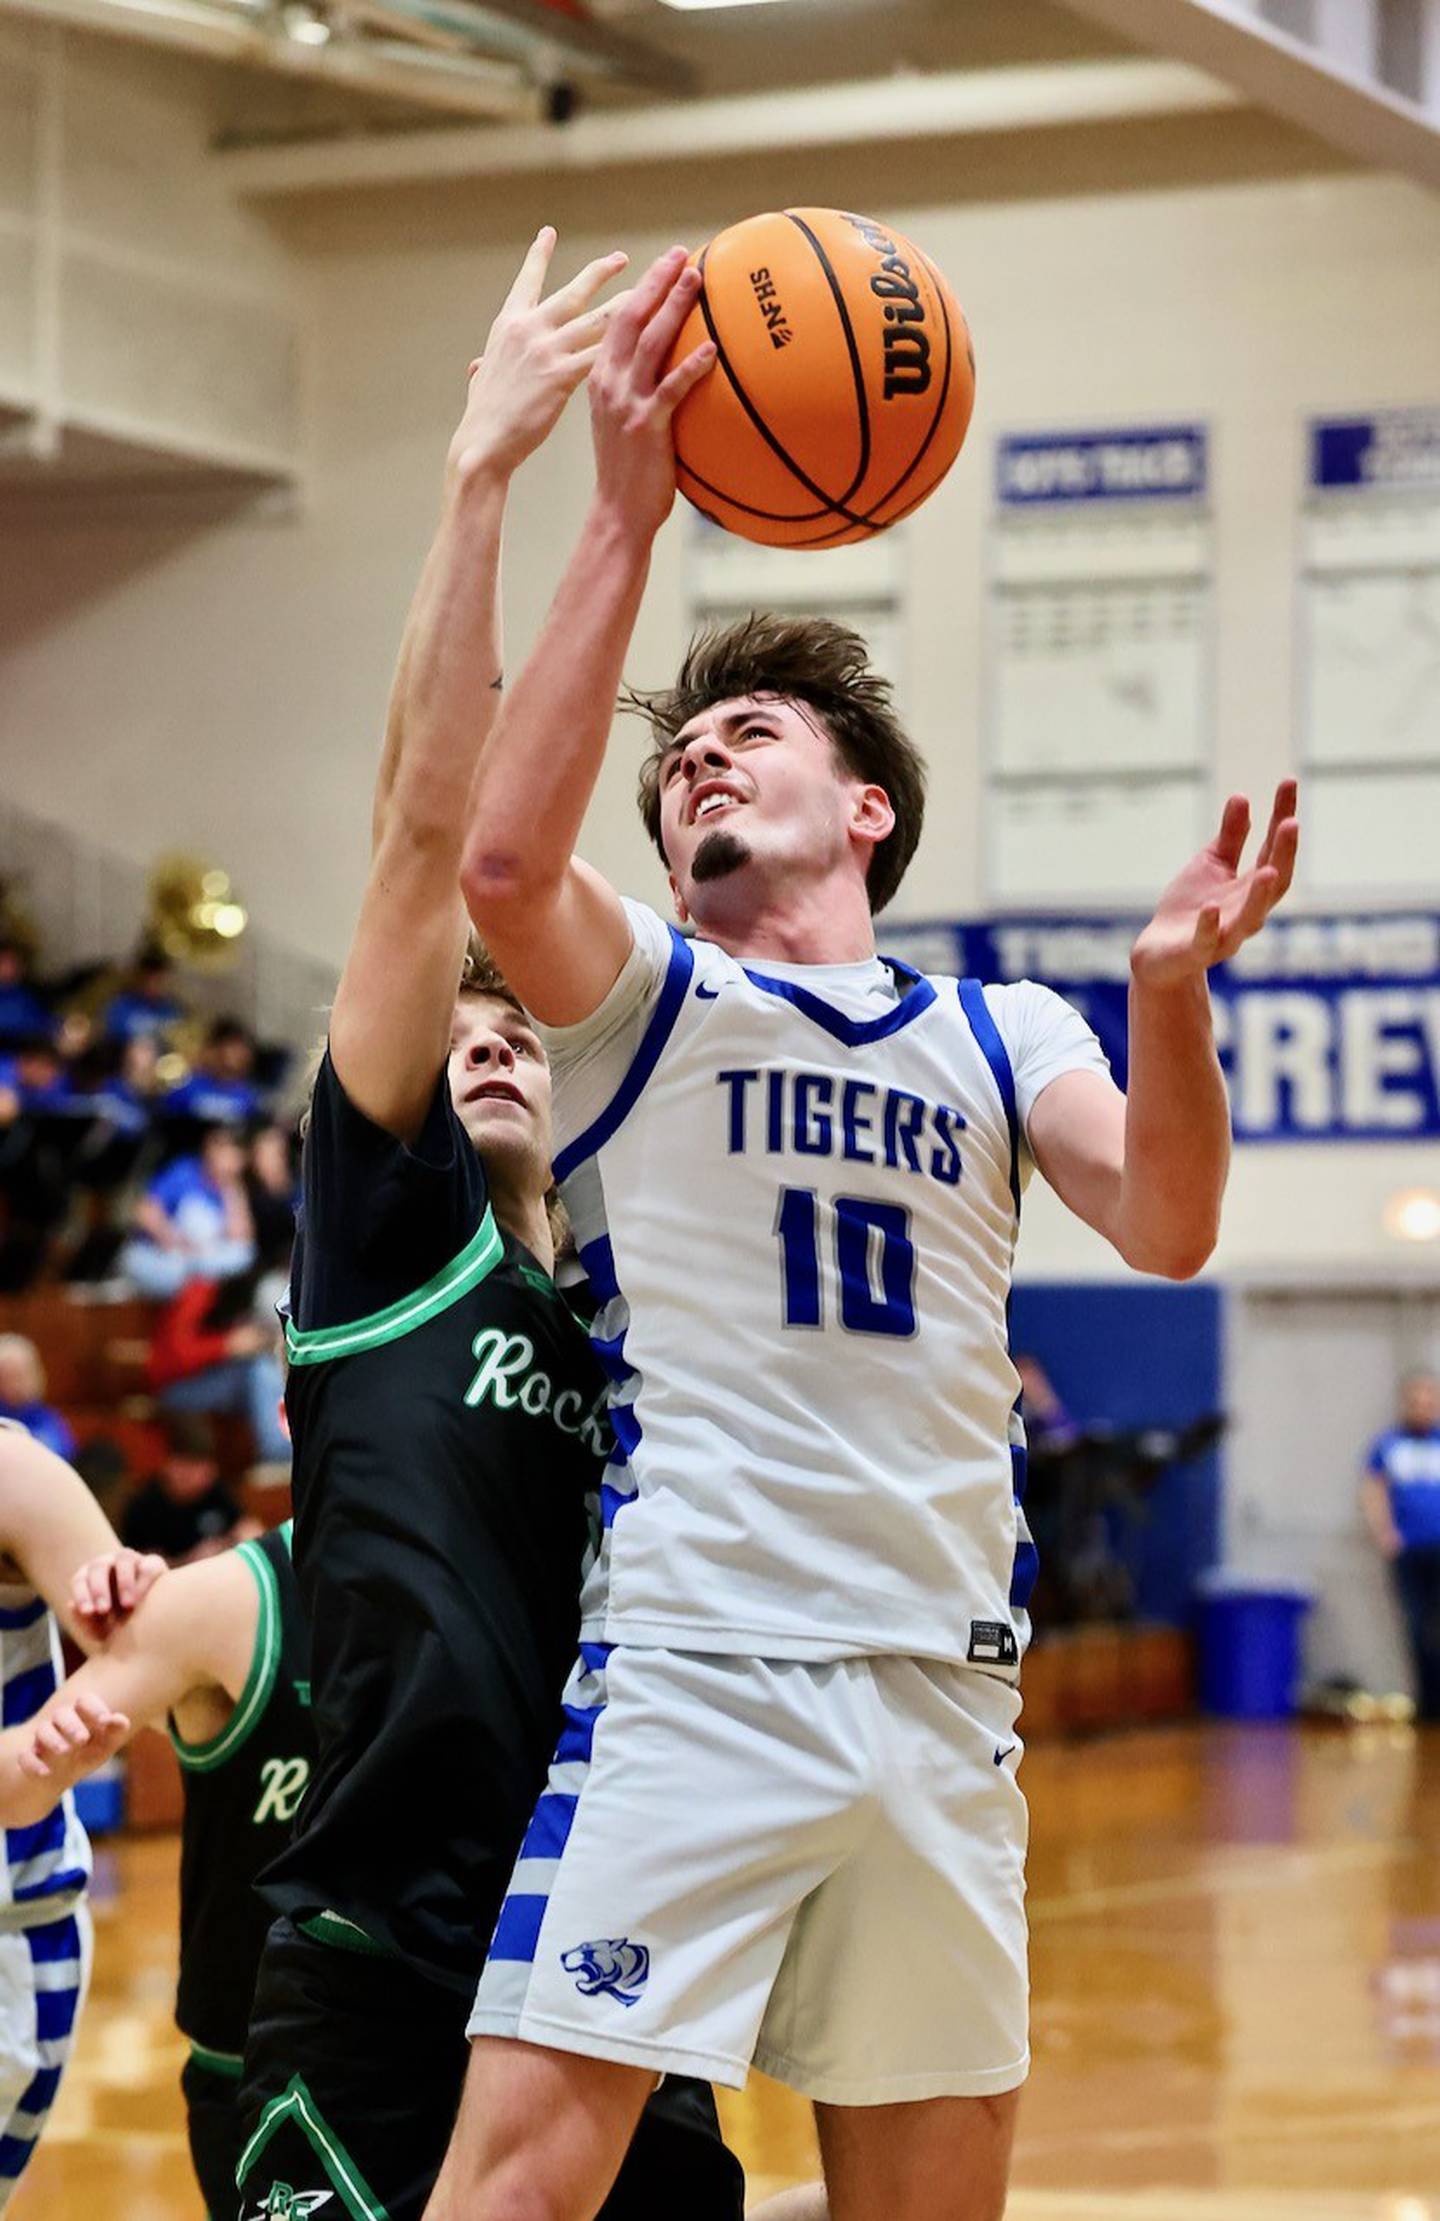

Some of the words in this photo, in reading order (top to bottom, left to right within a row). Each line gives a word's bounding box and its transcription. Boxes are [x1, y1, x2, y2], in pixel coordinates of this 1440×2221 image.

[750, 267, 787, 330] NFHS
[716, 1068, 967, 1186] TIGERS
[771, 1183, 920, 1342] 10
